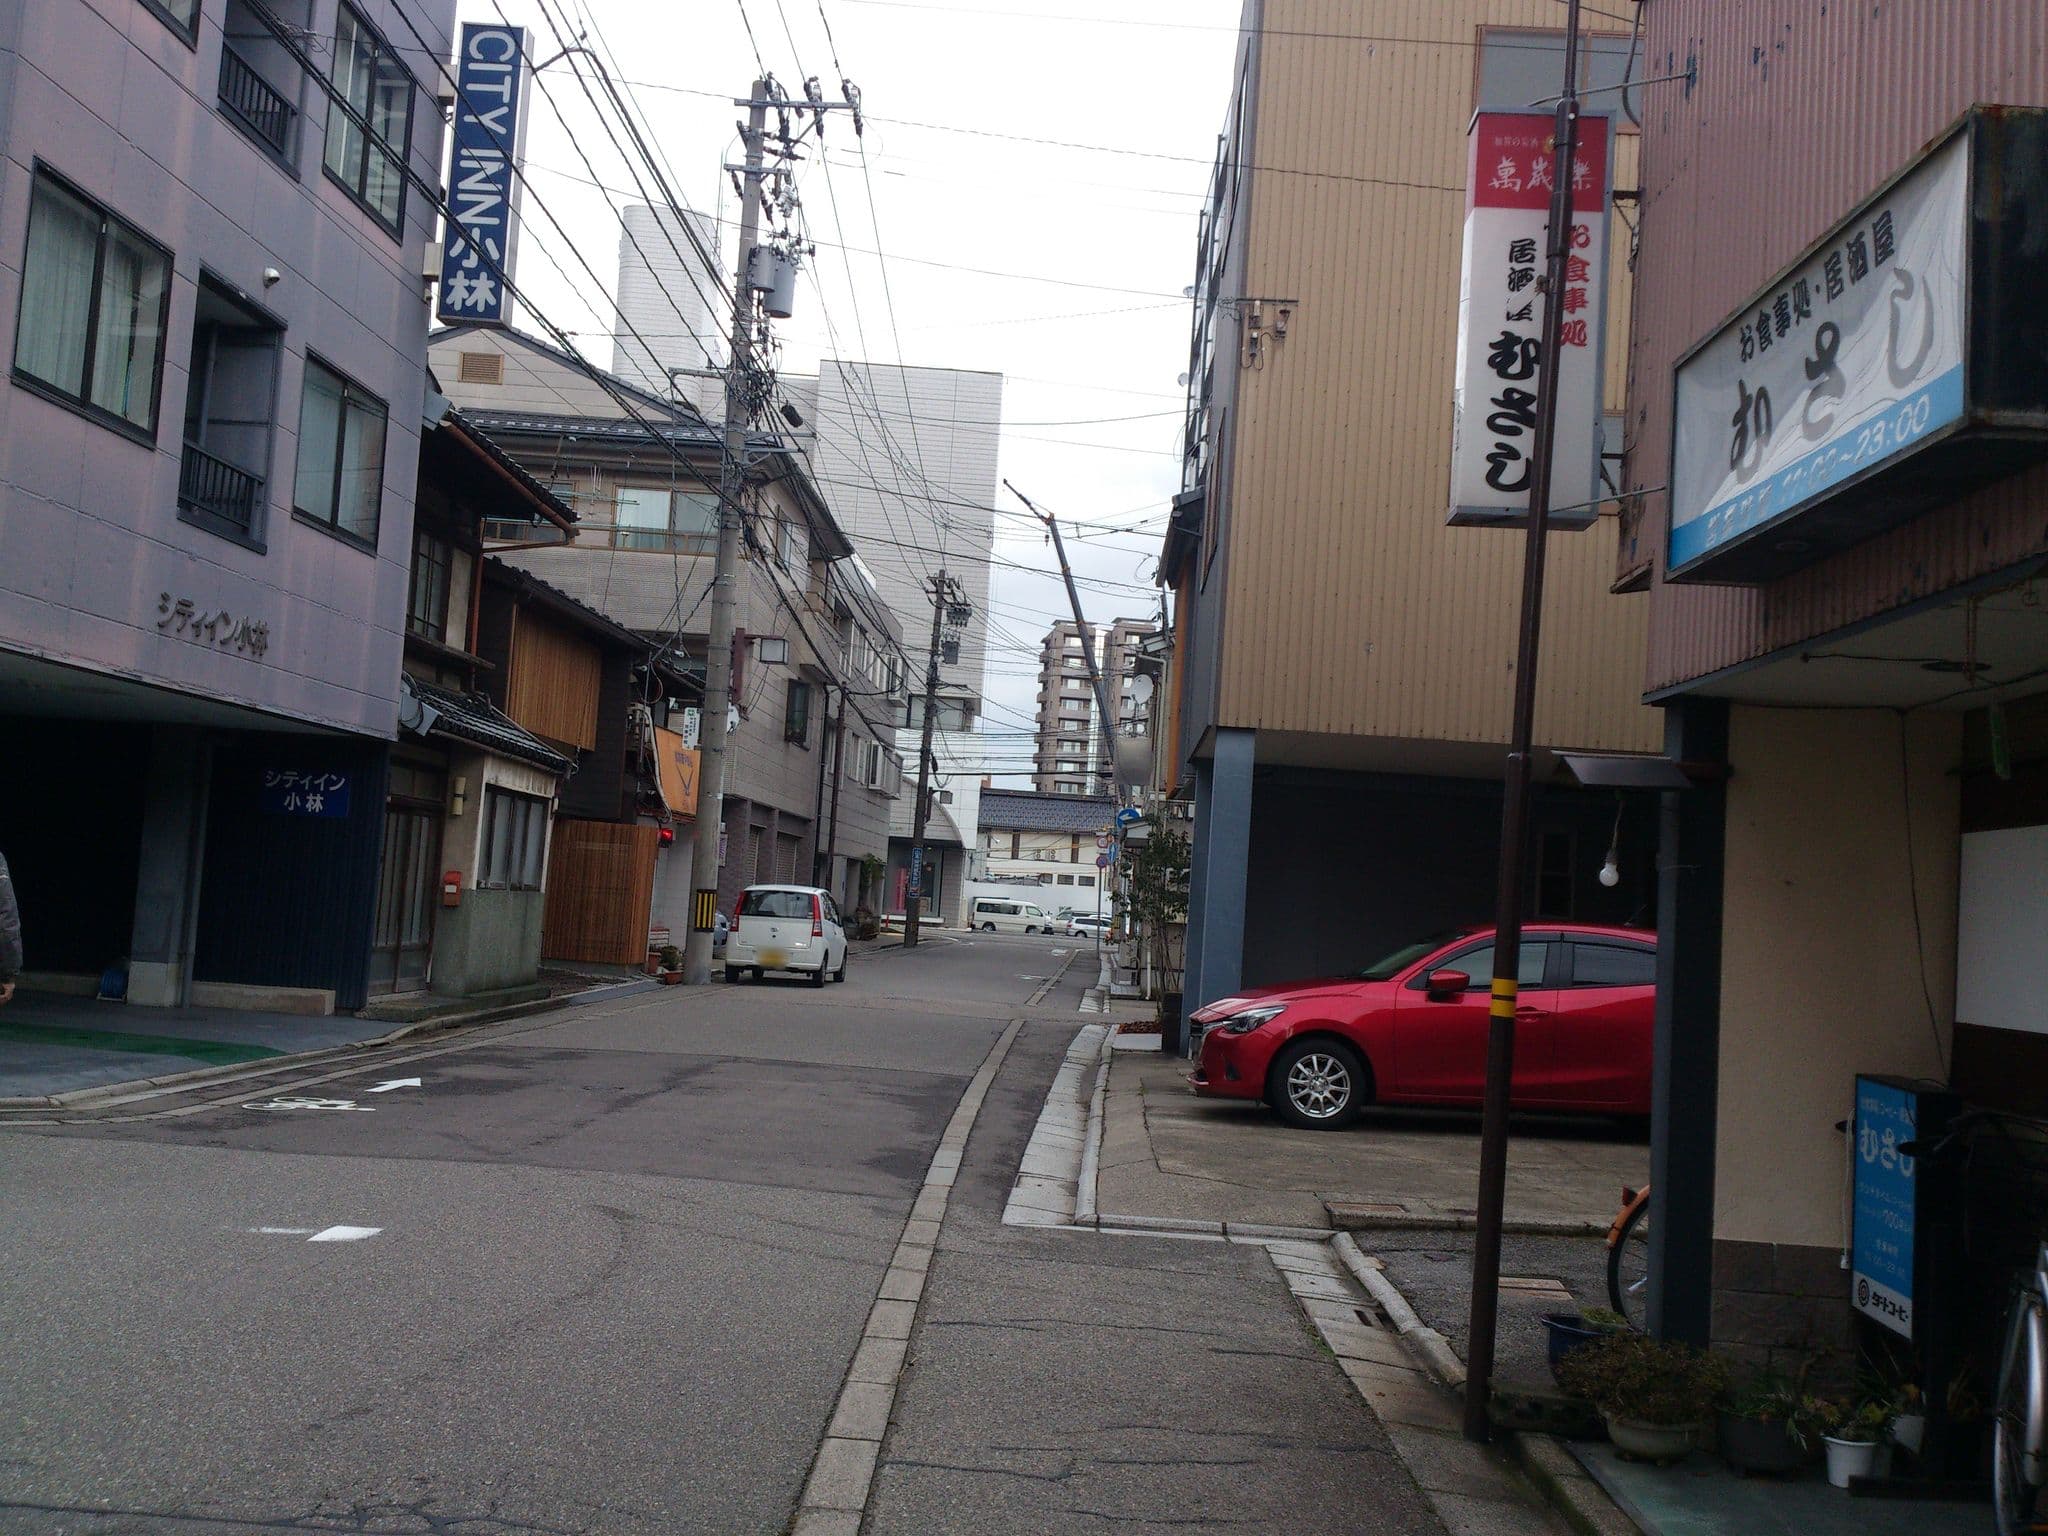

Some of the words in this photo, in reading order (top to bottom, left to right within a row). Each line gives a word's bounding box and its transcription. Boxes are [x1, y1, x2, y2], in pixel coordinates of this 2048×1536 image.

[462, 30, 516, 135] CITY
[456, 147, 505, 225] INN
[446, 226, 500, 313] 小林
[1560, 223, 1591, 347] お食事処
[1738, 209, 1896, 363] お食事処・居酒屋
[1486, 330, 1542, 493] むさし
[1729, 267, 1934, 485] むさし
[264, 770, 346, 792] シティイン
[284, 793, 324, 814] 小林
[1860, 1118, 1915, 1178] むさし
